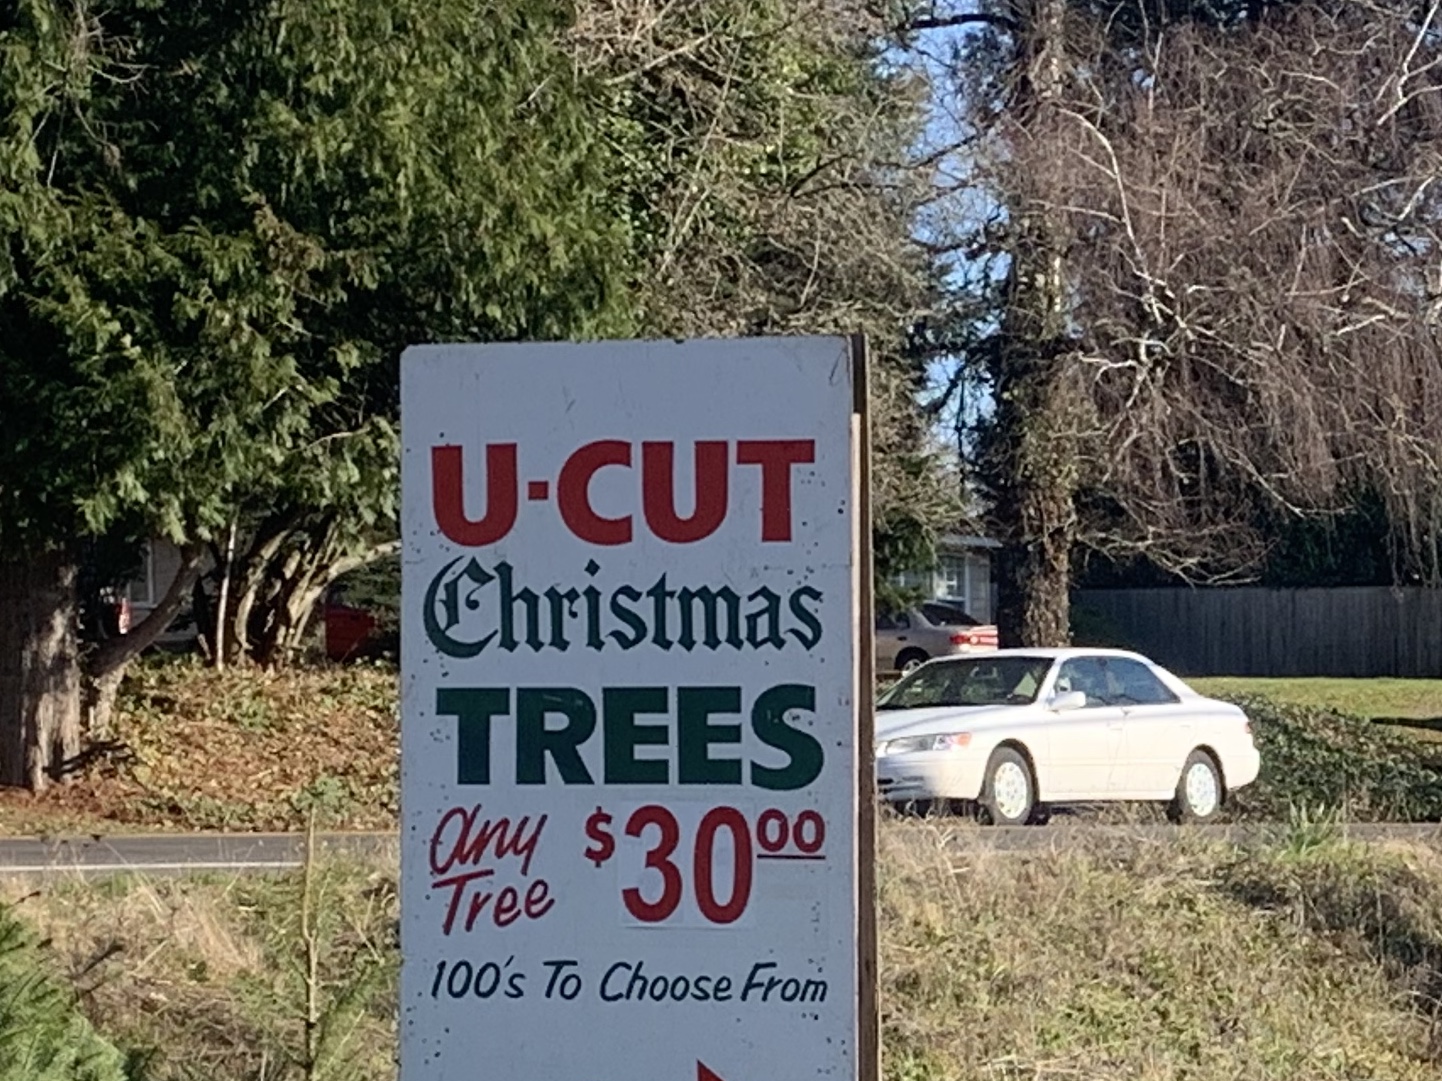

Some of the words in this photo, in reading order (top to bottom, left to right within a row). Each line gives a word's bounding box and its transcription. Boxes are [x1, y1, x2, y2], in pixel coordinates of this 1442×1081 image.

[430, 438, 816, 547] U-CUT
[422, 555, 824, 659] Christmas
[435, 684, 825, 791] TREES
[431, 868, 556, 936] Tree
[430, 955, 526, 999] 100's
[542, 959, 582, 1000] To
[599, 960, 733, 1002] Choose
[740, 961, 829, 1003] From
